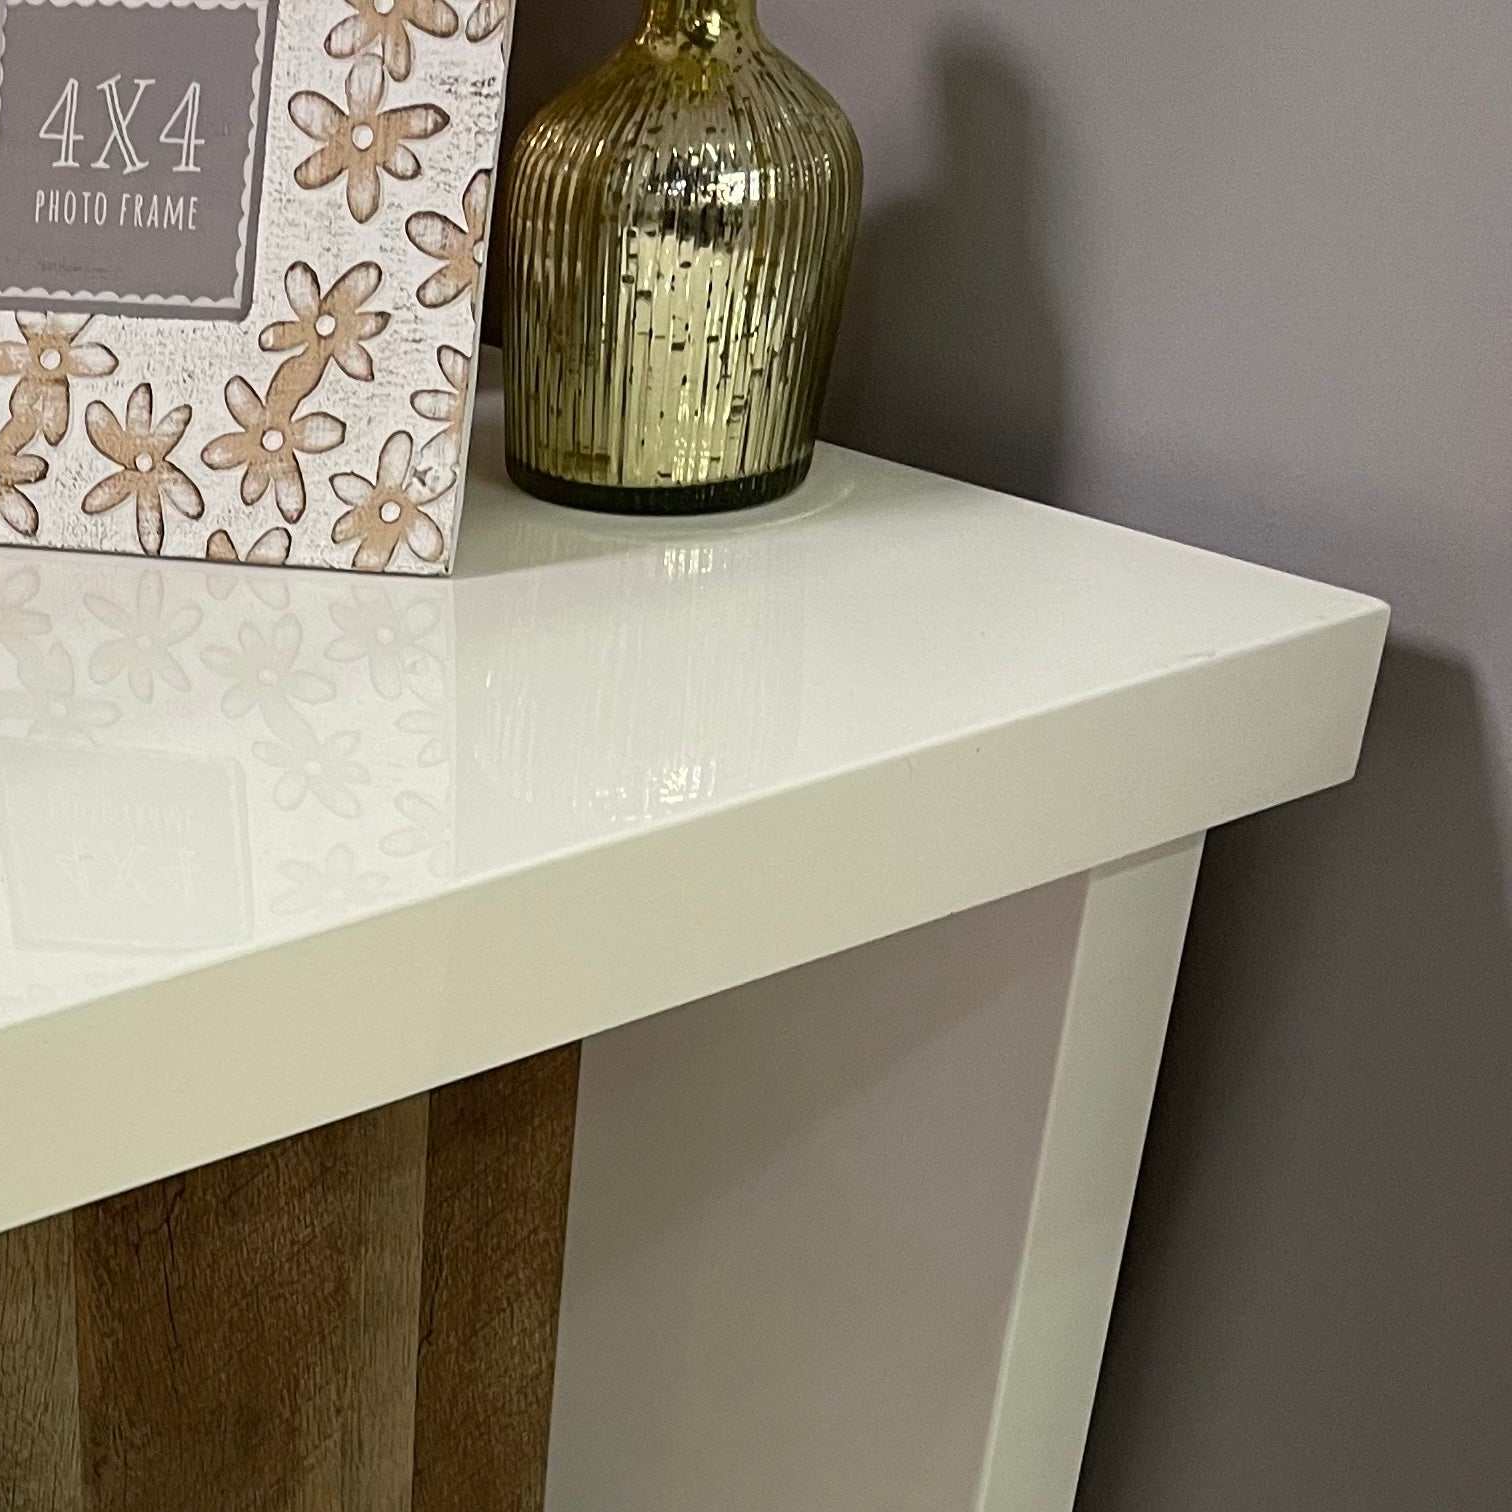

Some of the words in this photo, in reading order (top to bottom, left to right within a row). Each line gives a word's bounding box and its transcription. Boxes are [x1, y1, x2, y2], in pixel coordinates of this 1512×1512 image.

[39, 74, 205, 174] 4X4
[35, 190, 107, 225] PHOTO
[120, 193, 198, 231] FRAME
